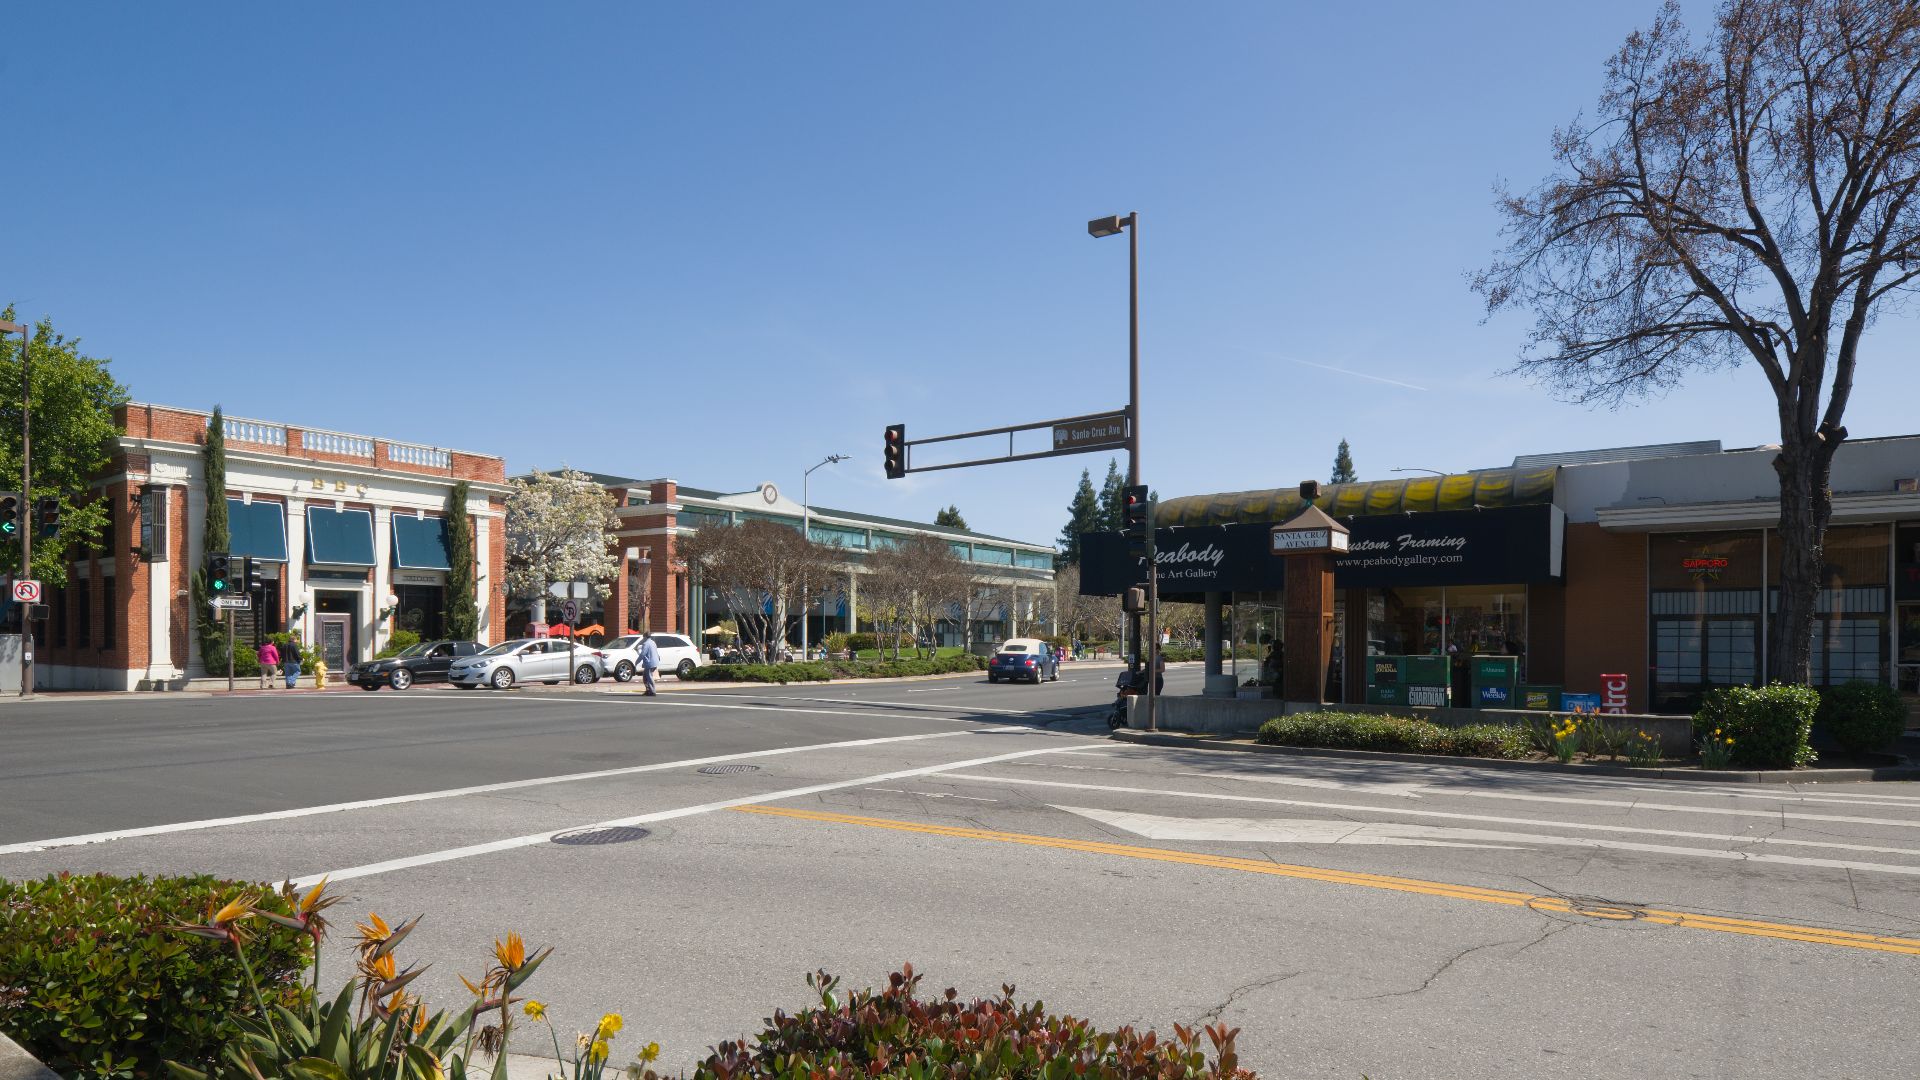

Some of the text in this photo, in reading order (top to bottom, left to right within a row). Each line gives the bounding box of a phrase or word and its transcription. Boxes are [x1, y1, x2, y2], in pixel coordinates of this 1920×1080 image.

[1072, 429, 1090, 440] Santa
[1092, 426, 1106, 438] Cruz
[1274, 532, 1302, 541] SANTA
[1304, 530, 1327, 540] CRUZ
[1286, 540, 1318, 548] AVENUE
[1348, 540, 1391, 551] ustom
[1397, 533, 1467, 551] Framing
[1336, 554, 1463, 568] www.peabodygallery.com
[1682, 559, 1728, 568] SAPPORO
[1168, 569, 1183, 579] Art
[1185, 568, 1218, 579] Gallery
[1409, 691, 1445, 706] GUARDIAN
[1482, 691, 1507, 700] Weekly
